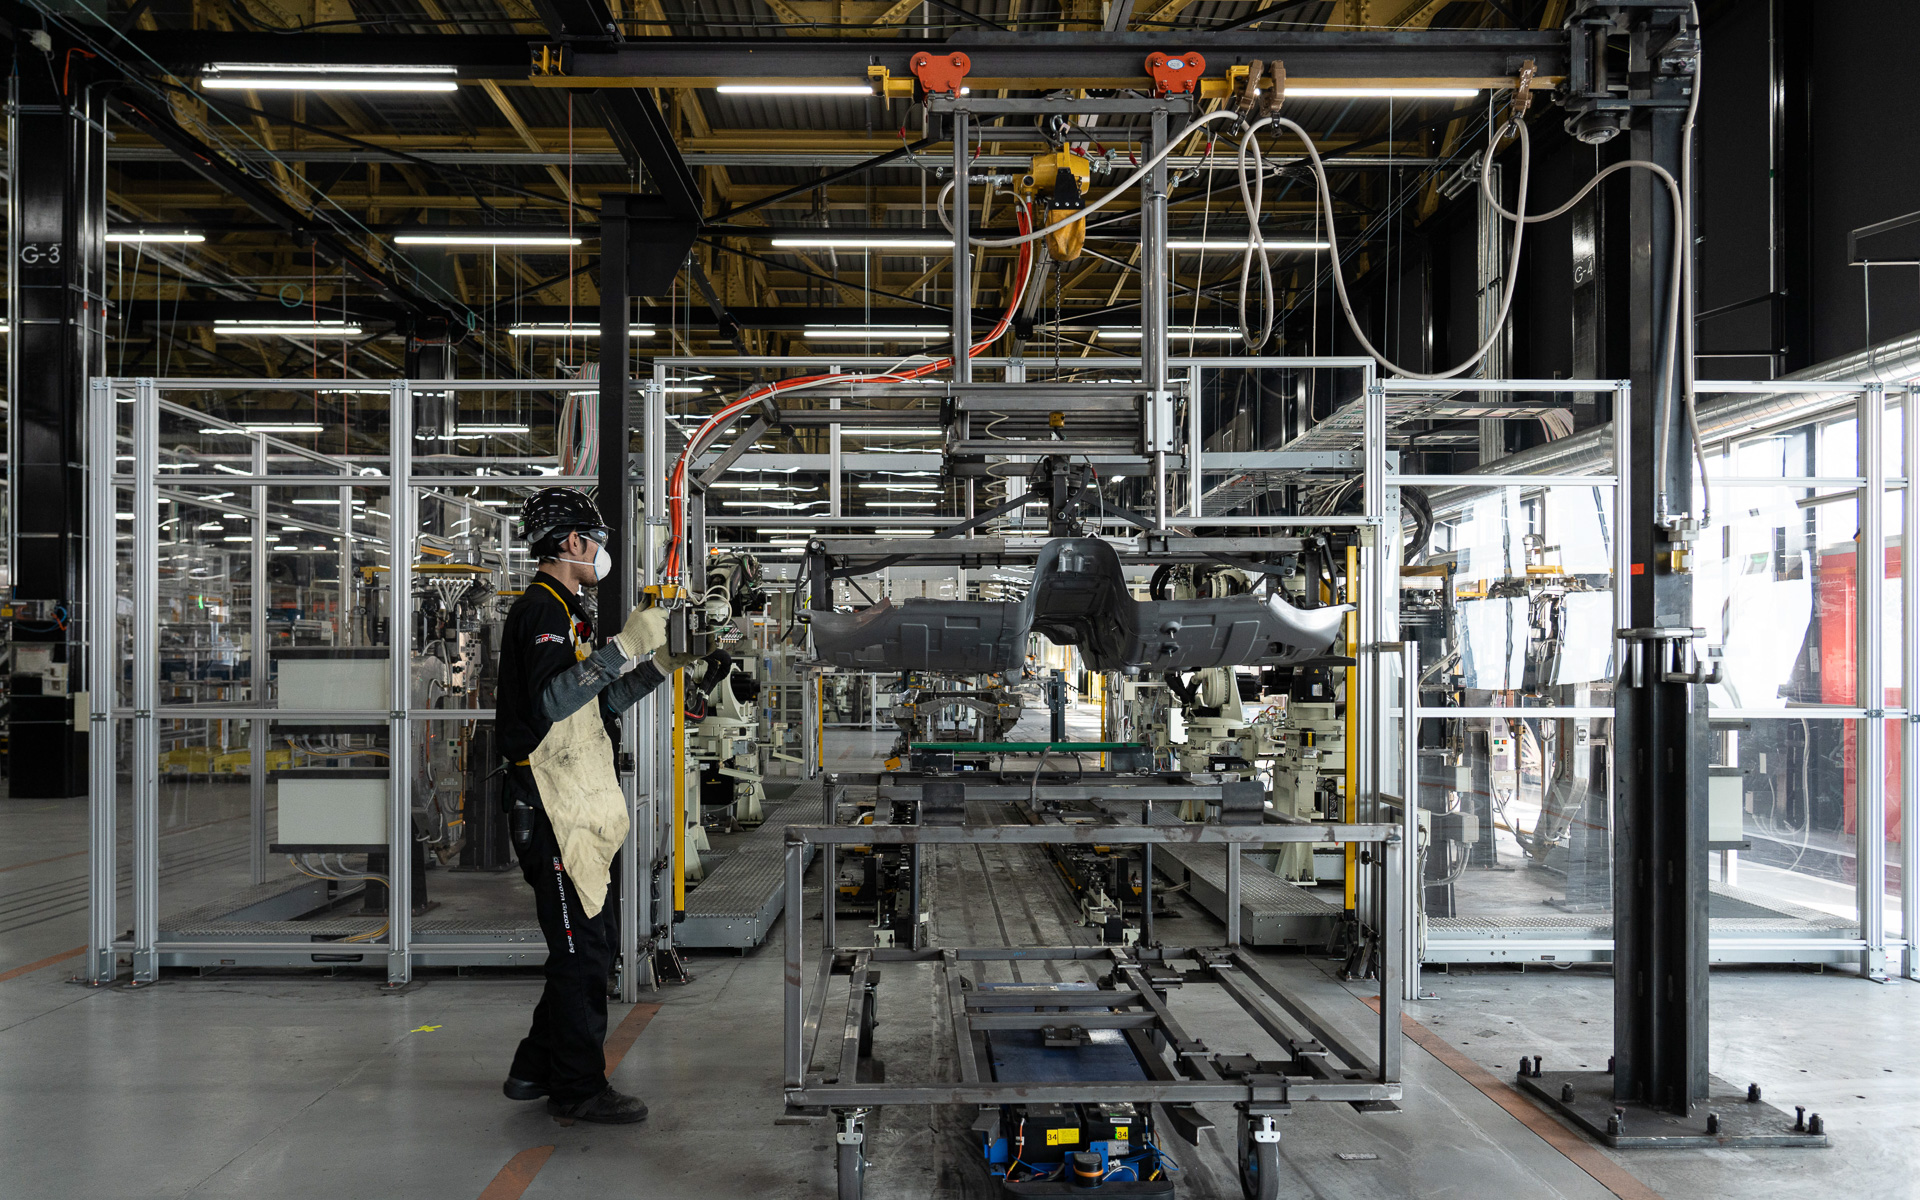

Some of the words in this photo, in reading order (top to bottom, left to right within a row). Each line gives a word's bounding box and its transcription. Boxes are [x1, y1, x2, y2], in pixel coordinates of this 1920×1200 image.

[21, 246, 60, 264] G-3
[1574, 260, 1593, 283] G-4
[556, 872, 565, 901] TOYOTA
[562, 902, 570, 929] GAZOO
[566, 930, 575, 953] Racing
[1117, 1131, 1127, 1139] 34
